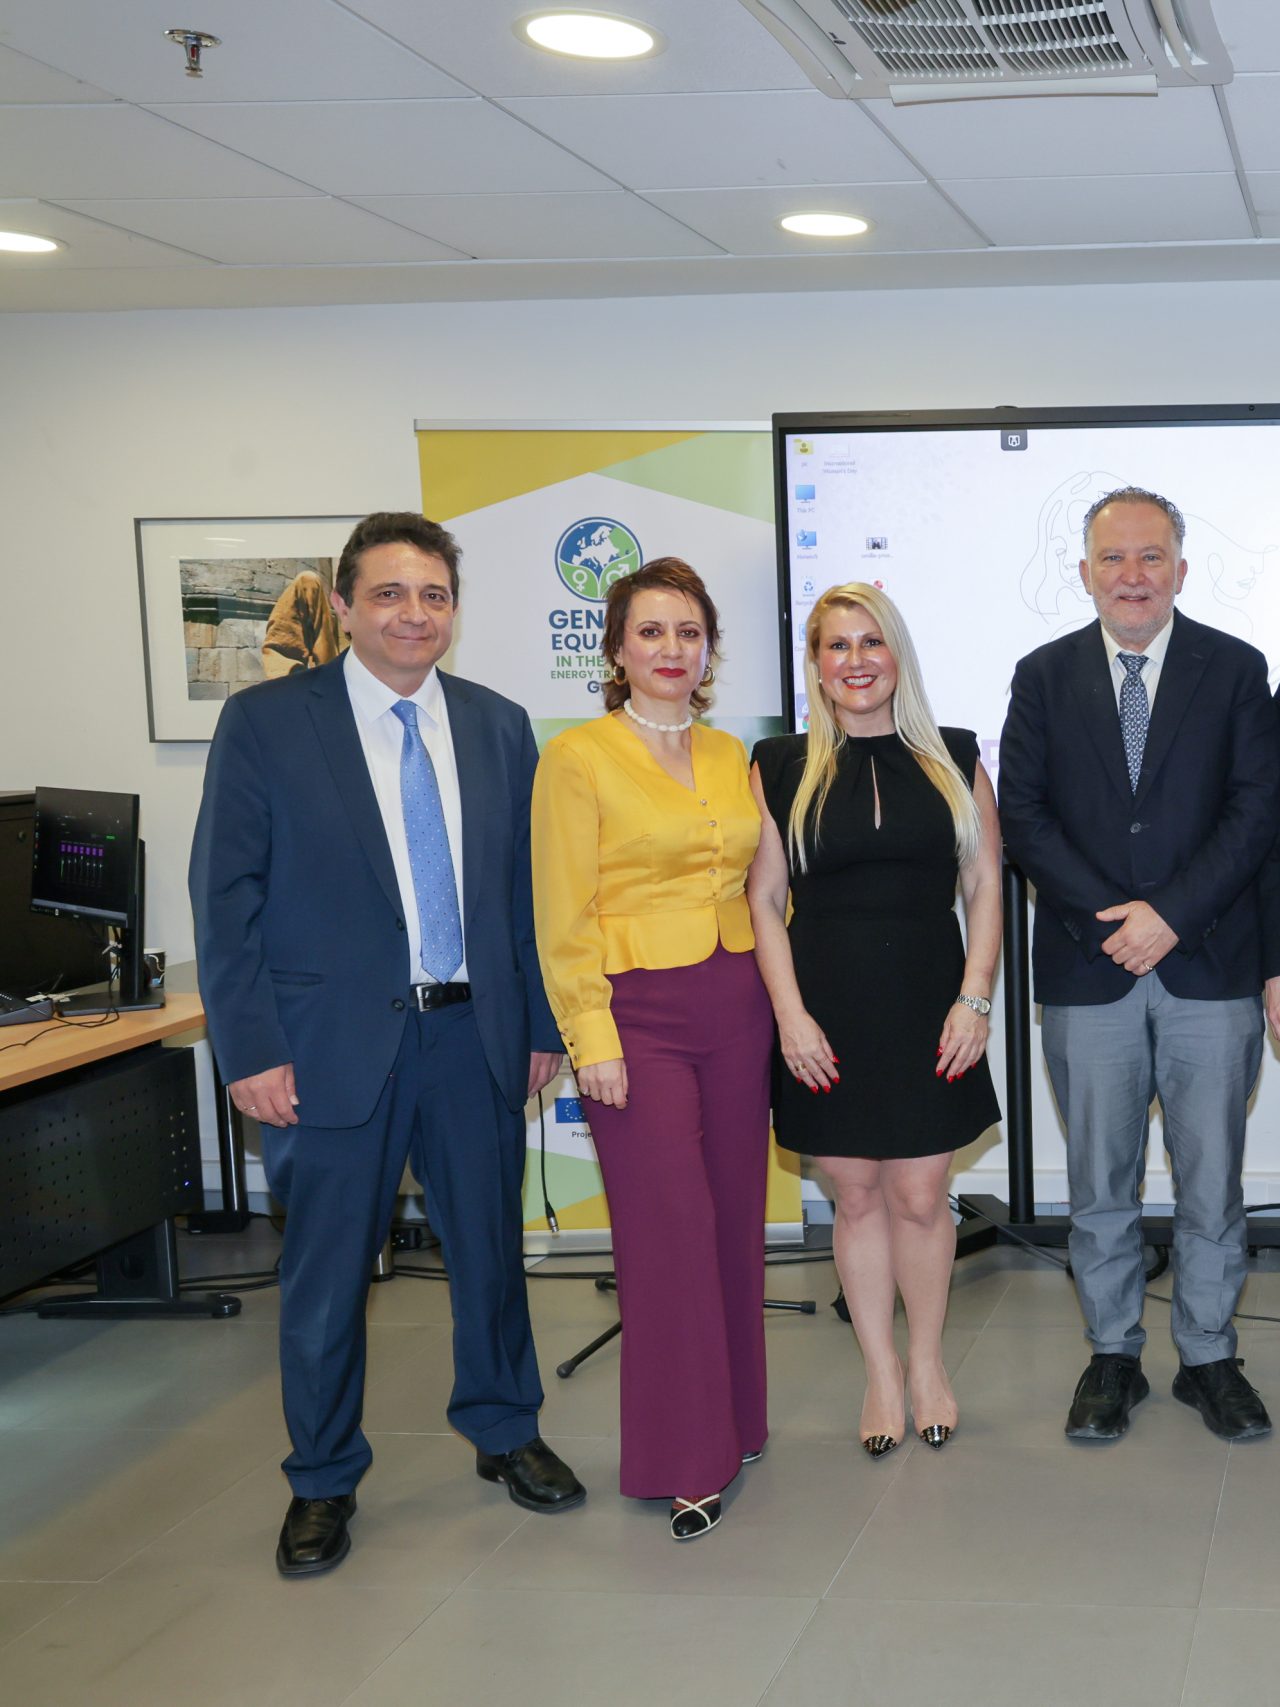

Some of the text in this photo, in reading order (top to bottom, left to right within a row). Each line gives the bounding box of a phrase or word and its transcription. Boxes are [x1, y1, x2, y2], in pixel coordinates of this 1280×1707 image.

[548, 609, 605, 630] GEN
[551, 633, 604, 653] EQU
[556, 655, 605, 667] IN THE
[550, 670, 615, 679] ENERGY TR
[571, 1131, 593, 1140] Proje
